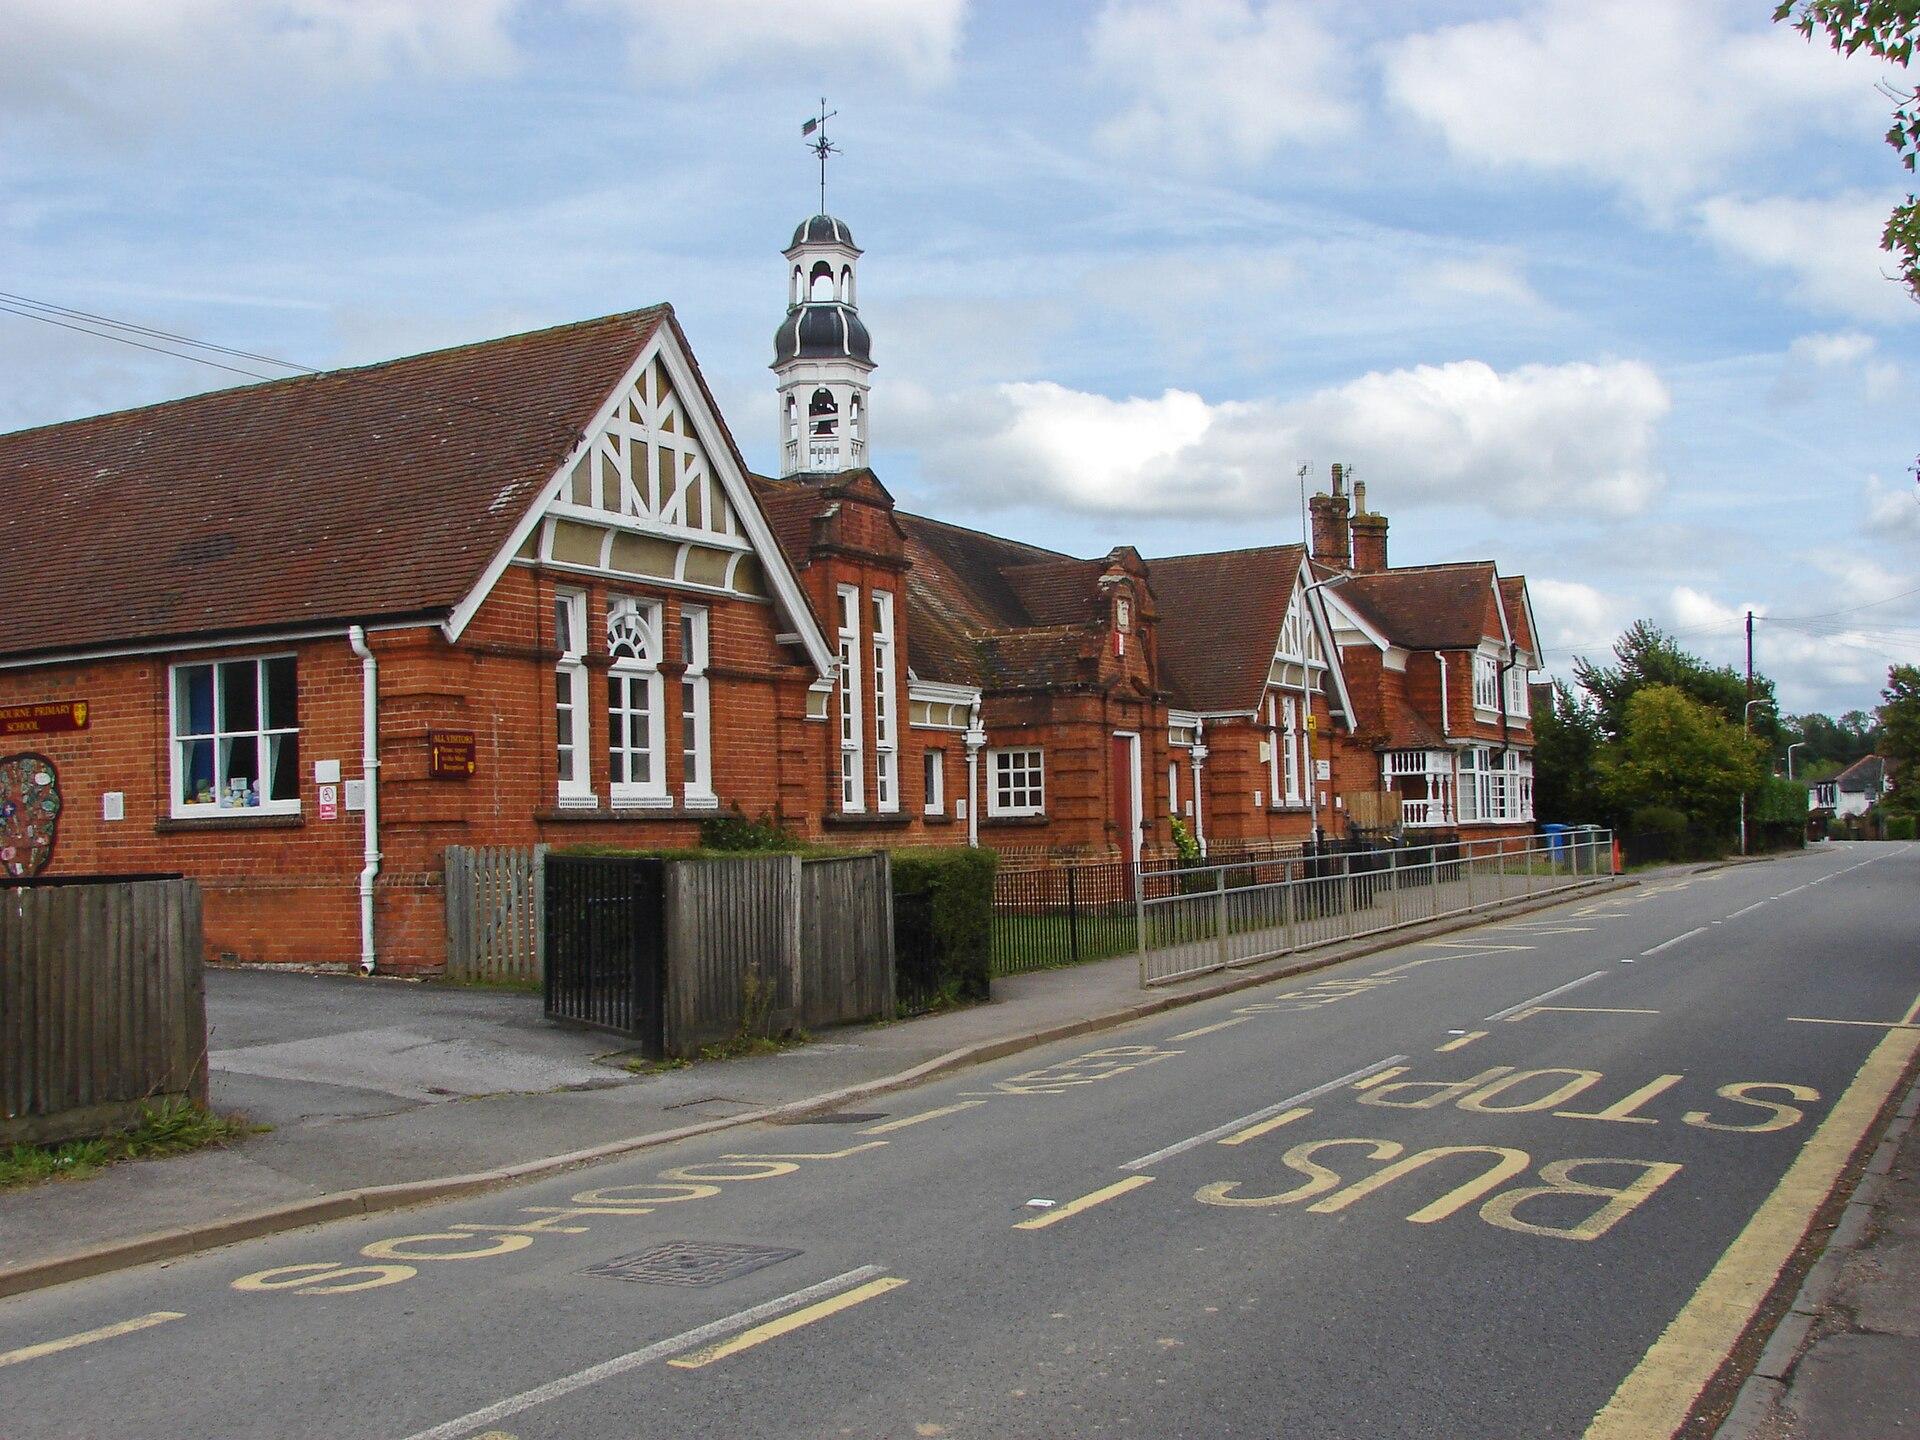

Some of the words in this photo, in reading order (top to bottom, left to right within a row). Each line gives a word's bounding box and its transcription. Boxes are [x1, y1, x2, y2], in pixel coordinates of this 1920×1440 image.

[7, 721, 39, 731] SCHOOL
[34, 705, 70, 716] PRIMARY
[433, 735, 446, 743] ALL
[447, 735, 473, 744] VISITORS
[1355, 1066, 1821, 1132] STOP
[230, 1140, 890, 1295] SCHOOL
[957, 1045, 1186, 1095] KEEP
[1195, 1138, 1683, 1241] BUS
